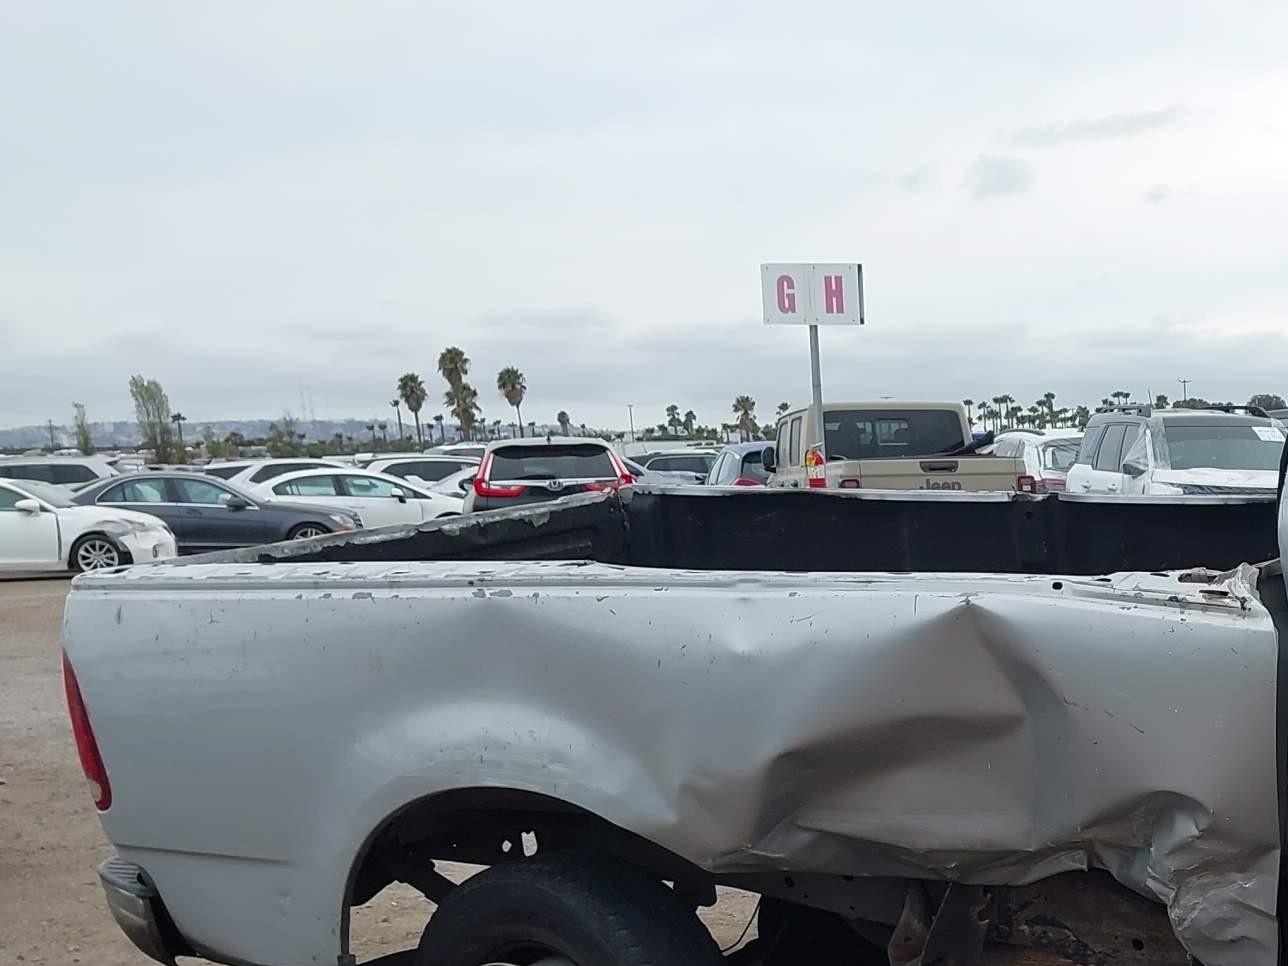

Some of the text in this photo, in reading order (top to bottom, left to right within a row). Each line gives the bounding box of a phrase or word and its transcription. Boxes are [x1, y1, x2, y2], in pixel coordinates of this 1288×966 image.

[776, 275, 844, 314] G H
[919, 478, 962, 490] Jeep
